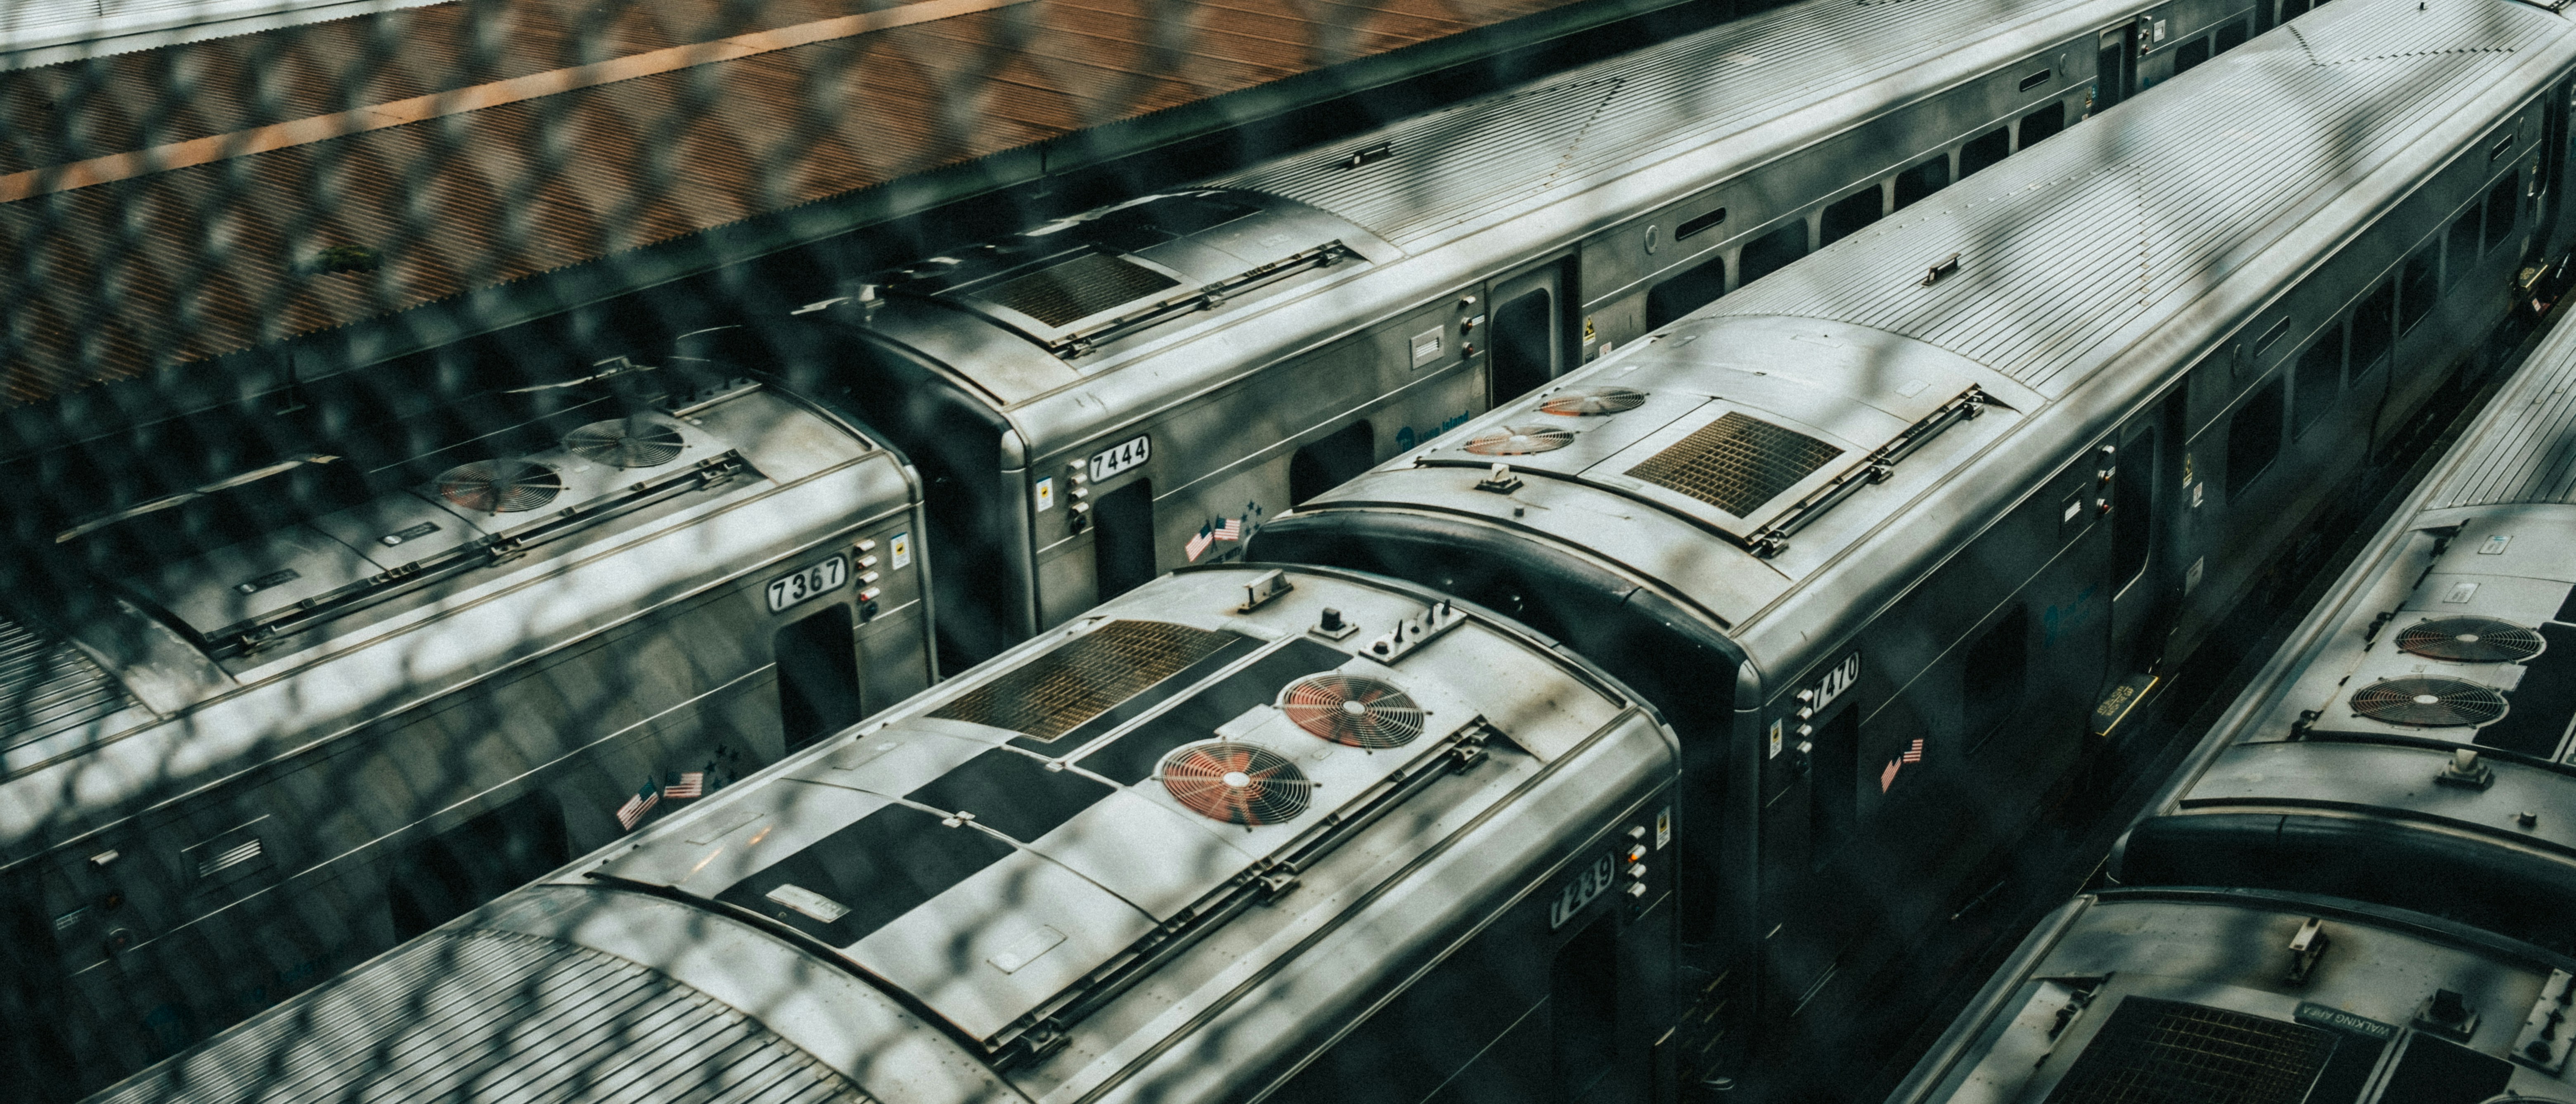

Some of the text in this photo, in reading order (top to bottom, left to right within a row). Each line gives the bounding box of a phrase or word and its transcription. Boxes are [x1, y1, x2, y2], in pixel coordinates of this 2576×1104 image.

[1442, 410, 1469, 431] Island
[1093, 438, 1146, 477] 7444
[773, 560, 838, 607] 7367
[1815, 655, 1856, 708] 7470
[1553, 855, 1611, 923] 7239
[2303, 1005, 2389, 1036] WALKING AREA
